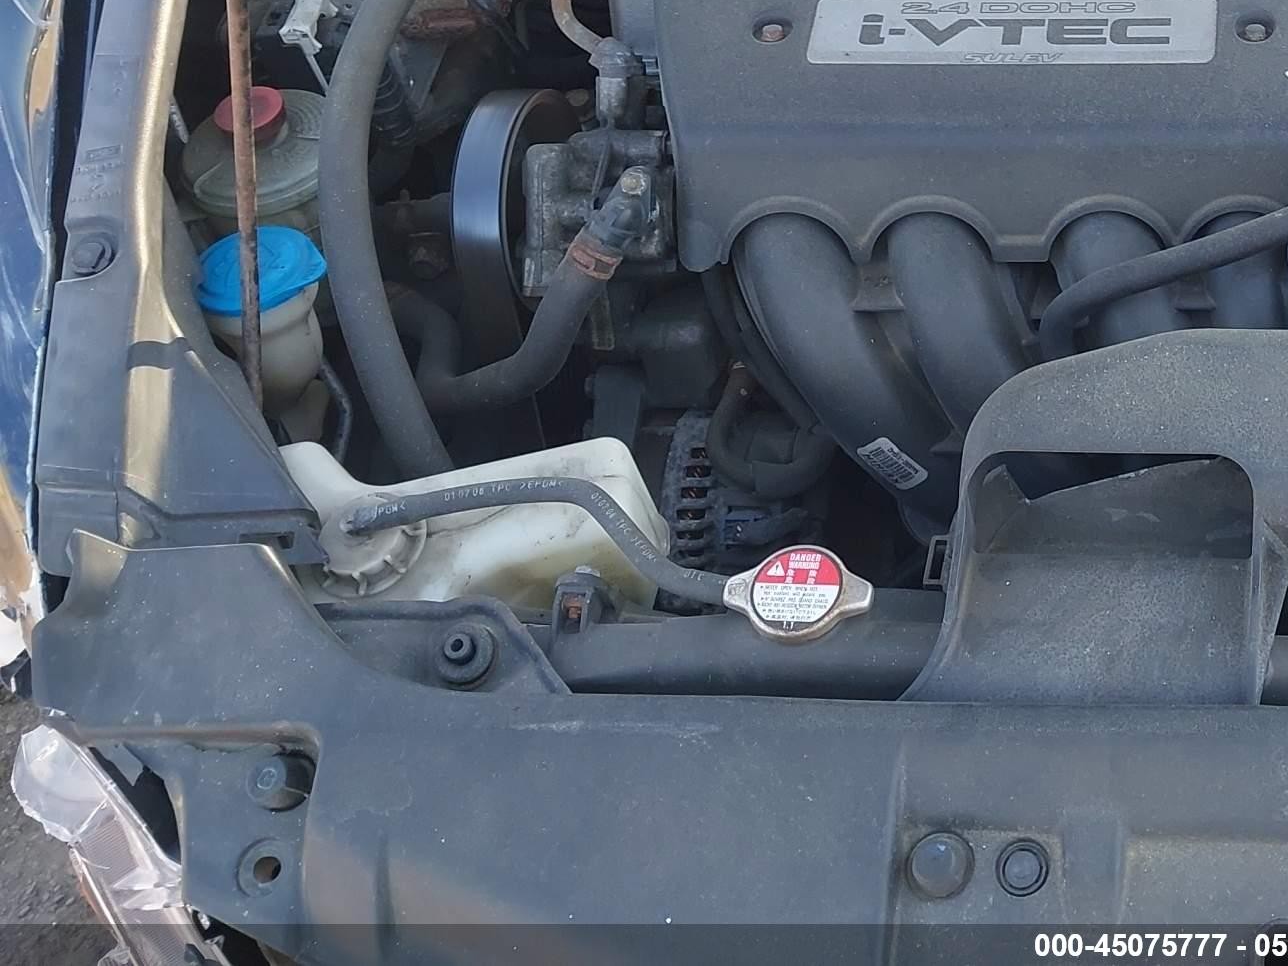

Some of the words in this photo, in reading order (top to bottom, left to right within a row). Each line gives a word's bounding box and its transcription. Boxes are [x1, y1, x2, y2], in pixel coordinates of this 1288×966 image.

[900, 1, 969, 15] 2.4
[979, 1, 1136, 15] DOHC
[858, 14, 1173, 46] i-VTEC
[960, 52, 1065, 64] SULEV
[790, 553, 822, 562] DANGER
